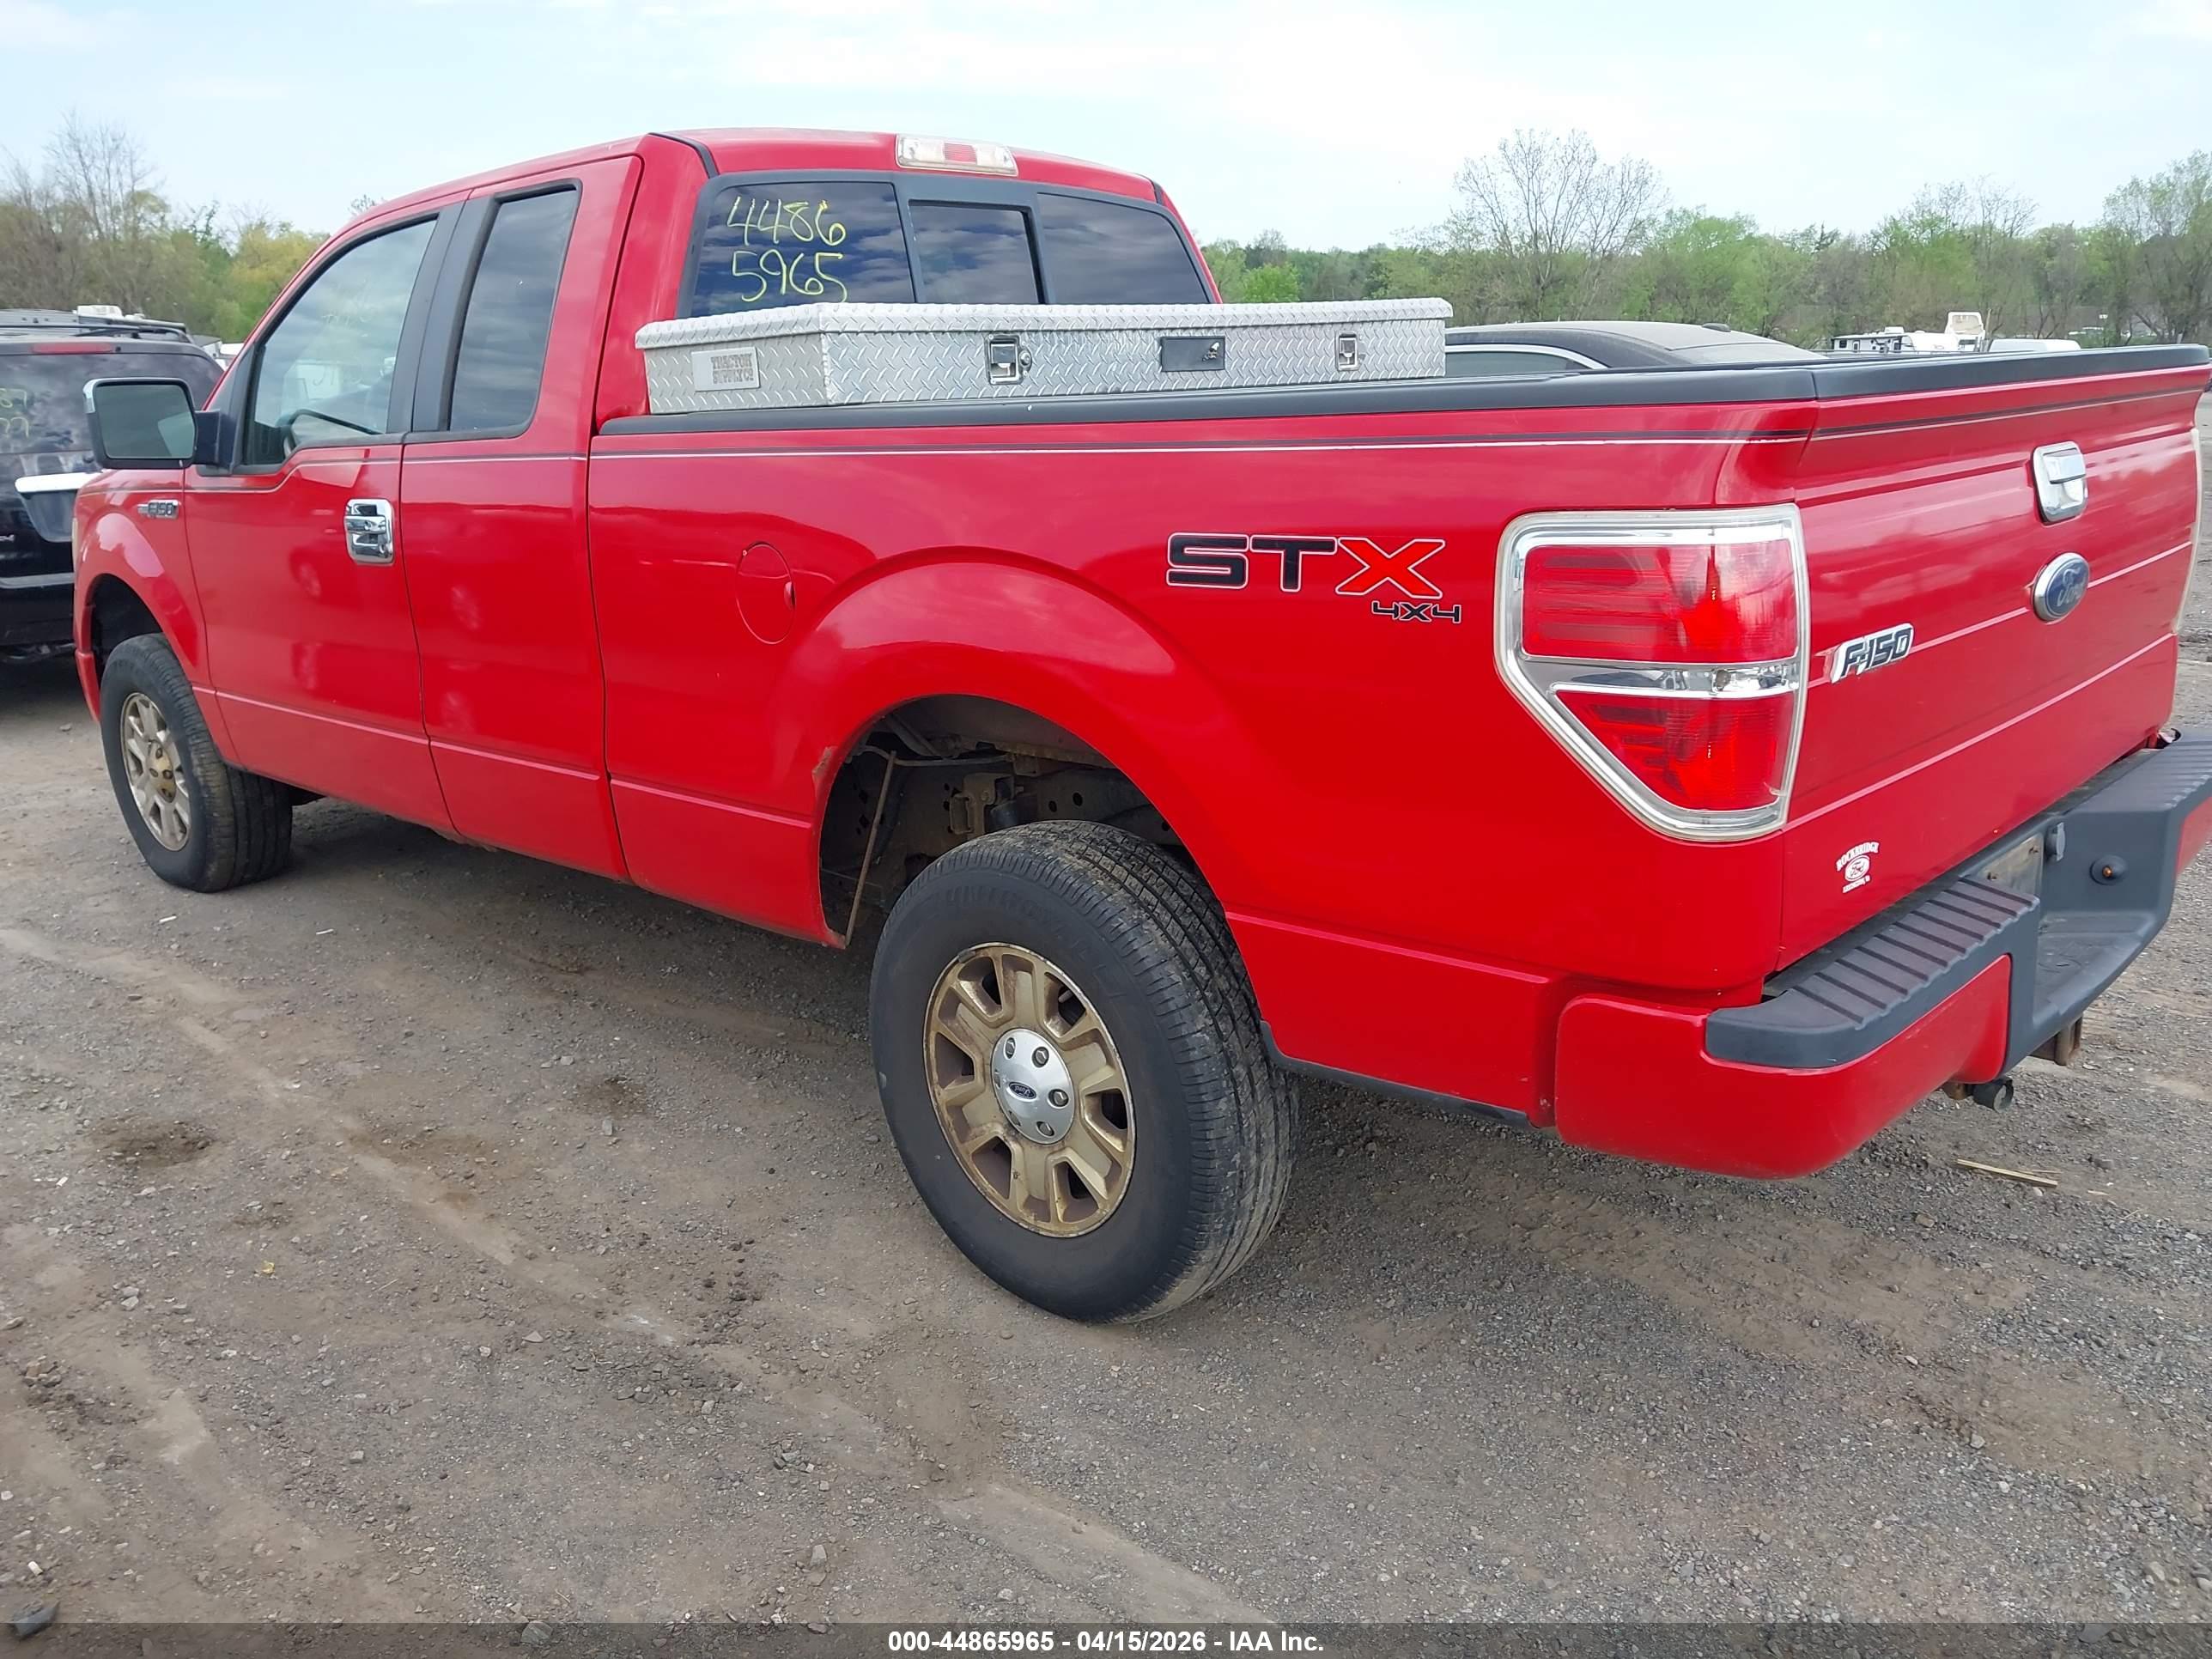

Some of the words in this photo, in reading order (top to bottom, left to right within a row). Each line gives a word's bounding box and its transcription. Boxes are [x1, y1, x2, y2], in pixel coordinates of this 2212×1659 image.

[727, 196, 846, 246] 4486
[732, 249, 848, 302] 5965
[1166, 532, 1446, 599] STX
[1832, 623, 1913, 681] F-150
